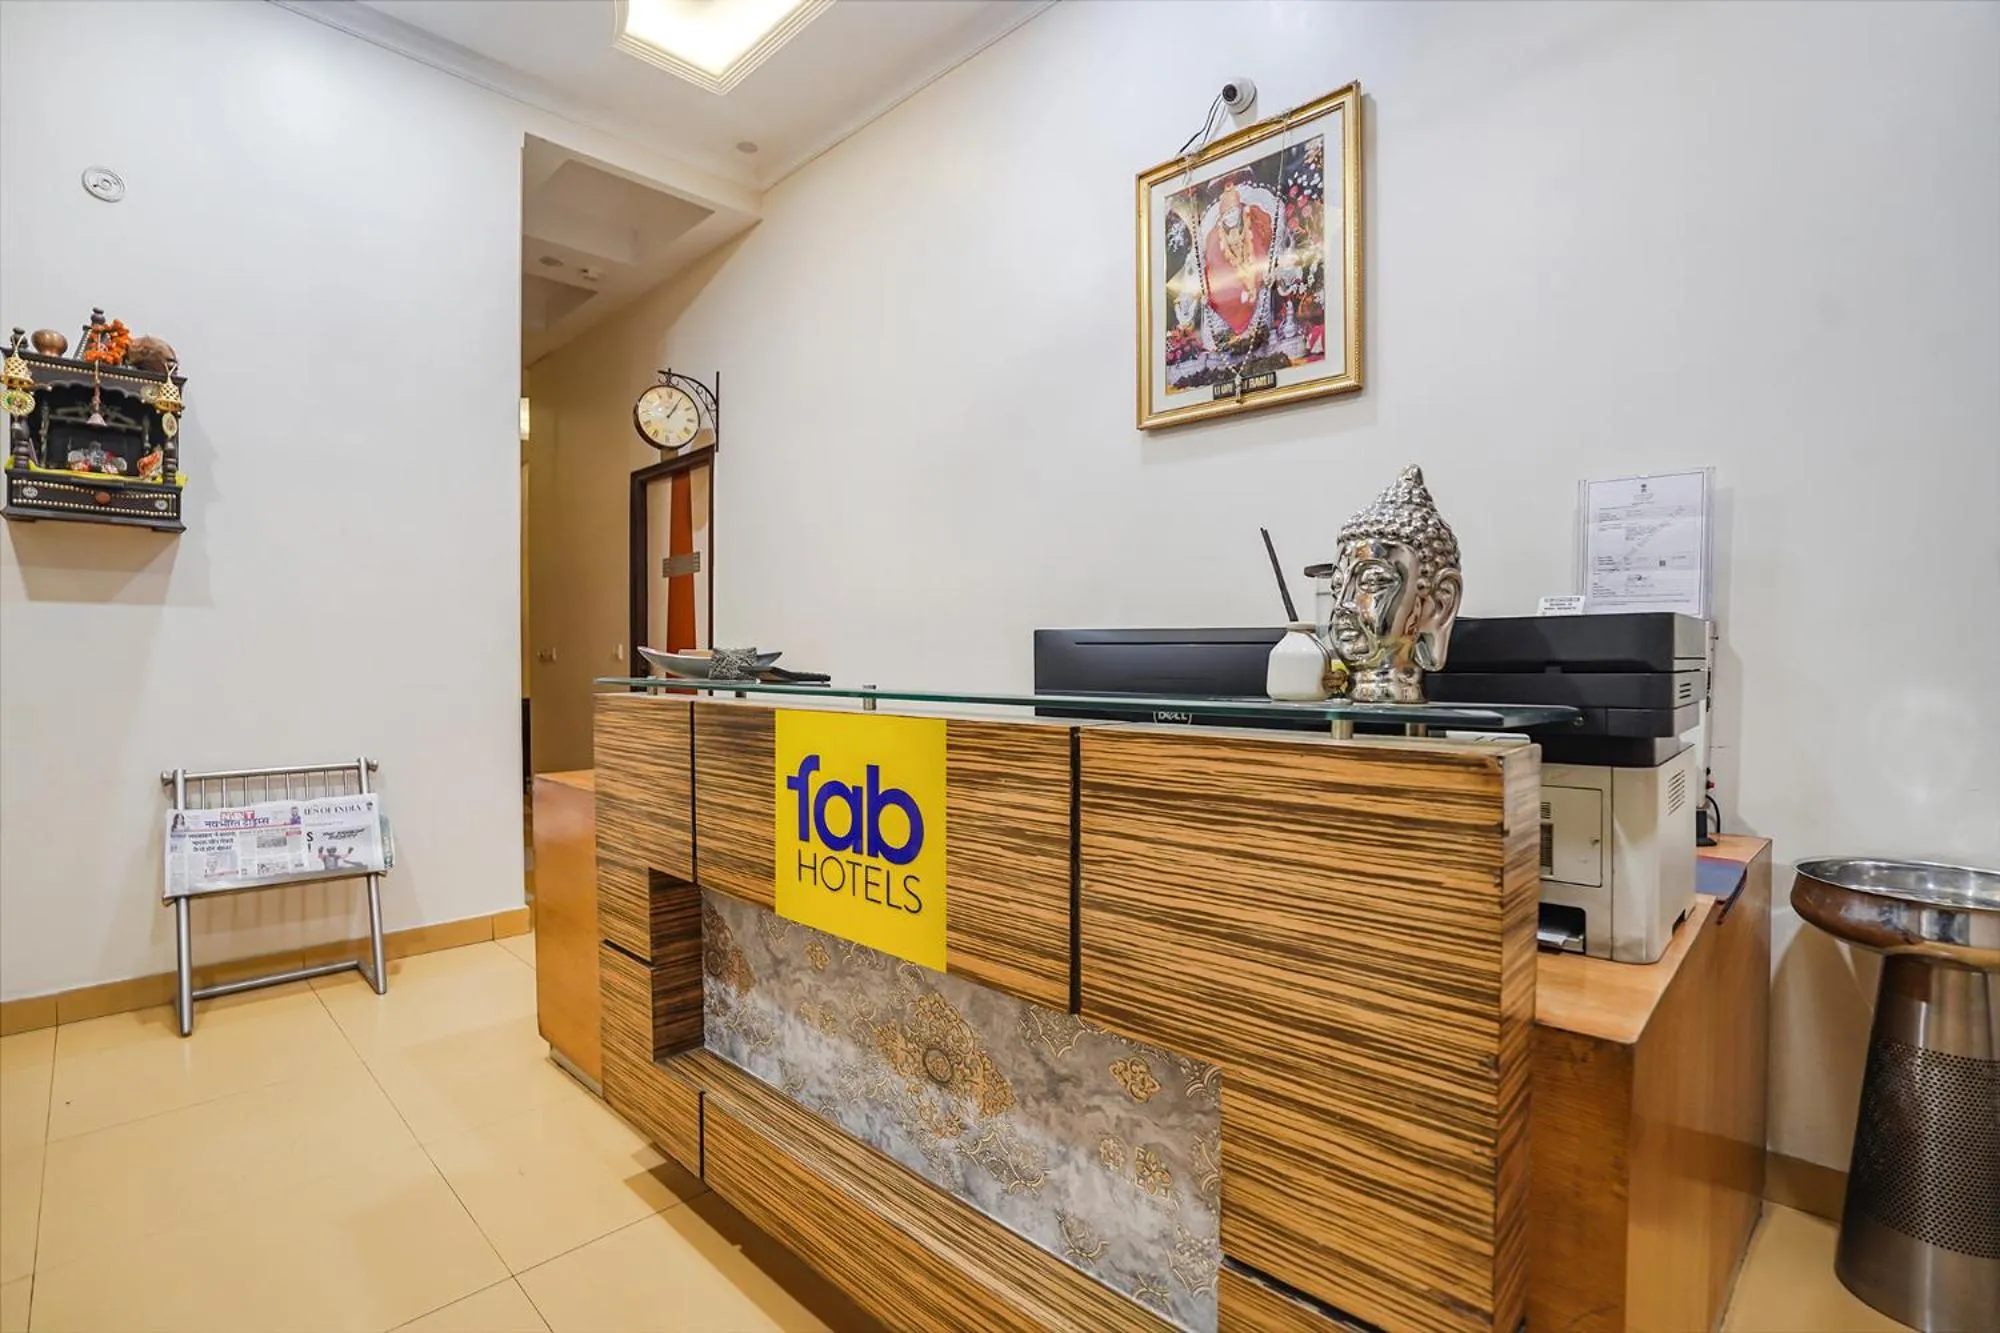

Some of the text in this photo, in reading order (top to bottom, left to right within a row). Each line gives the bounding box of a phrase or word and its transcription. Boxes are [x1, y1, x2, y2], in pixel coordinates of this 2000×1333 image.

[1158, 711, 1188, 721] DELL
[335, 804, 361, 813] INDIA
[786, 754, 925, 866] fab
[798, 849, 923, 914] HOTELS
